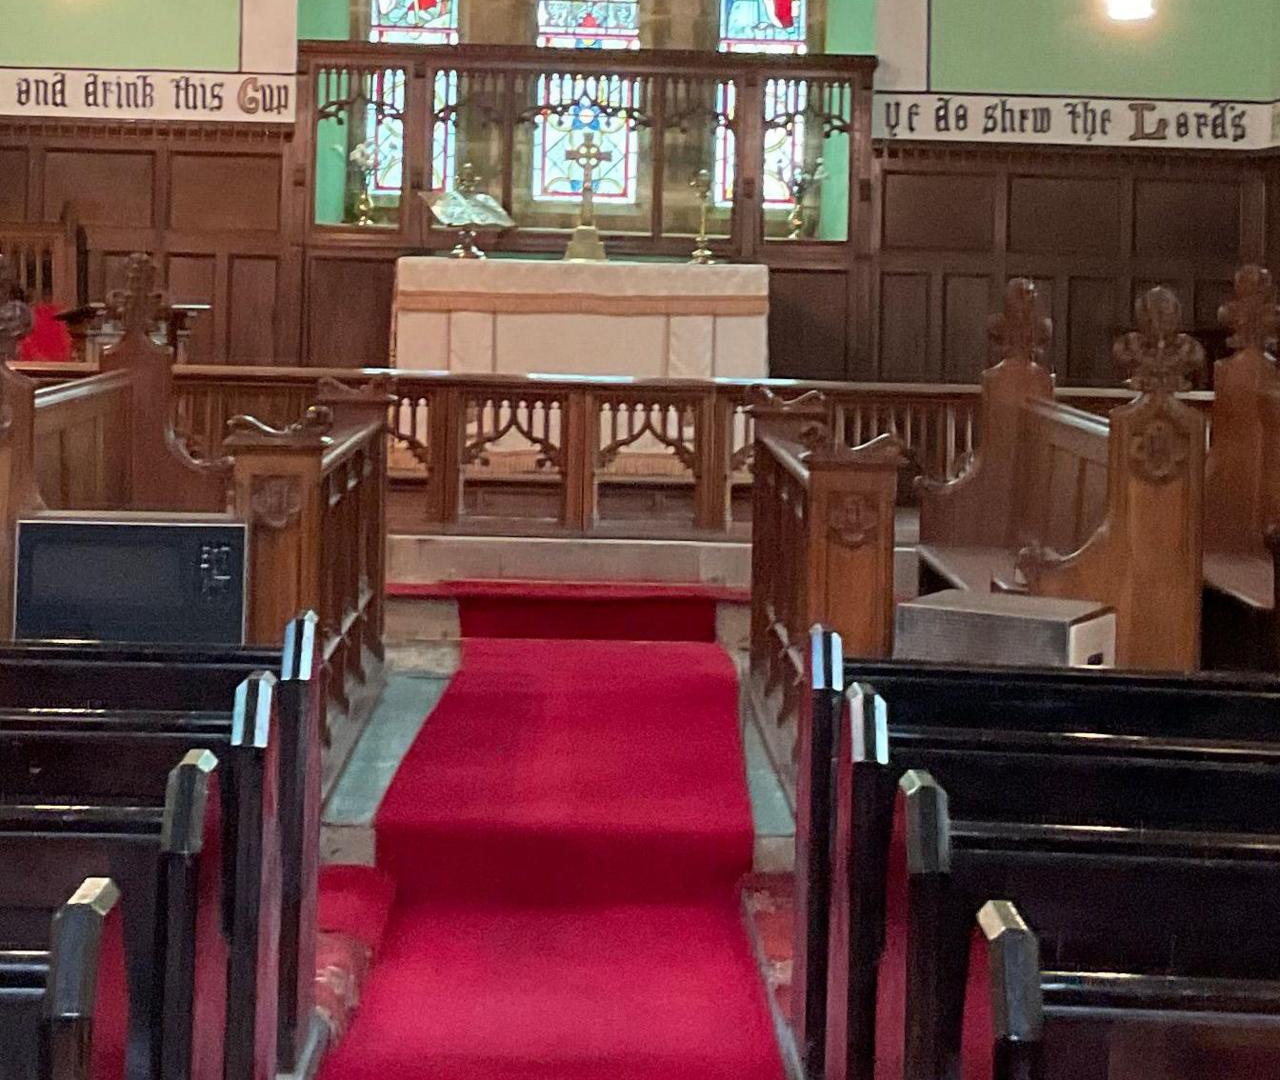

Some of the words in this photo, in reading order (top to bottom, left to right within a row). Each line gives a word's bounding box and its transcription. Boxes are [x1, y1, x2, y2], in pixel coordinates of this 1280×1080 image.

[16, 72, 67, 107] and
[84, 73, 155, 109] drink
[170, 76, 225, 111] this
[237, 76, 289, 115] Cup
[935, 97, 968, 131] do
[1064, 101, 1112, 141] the
